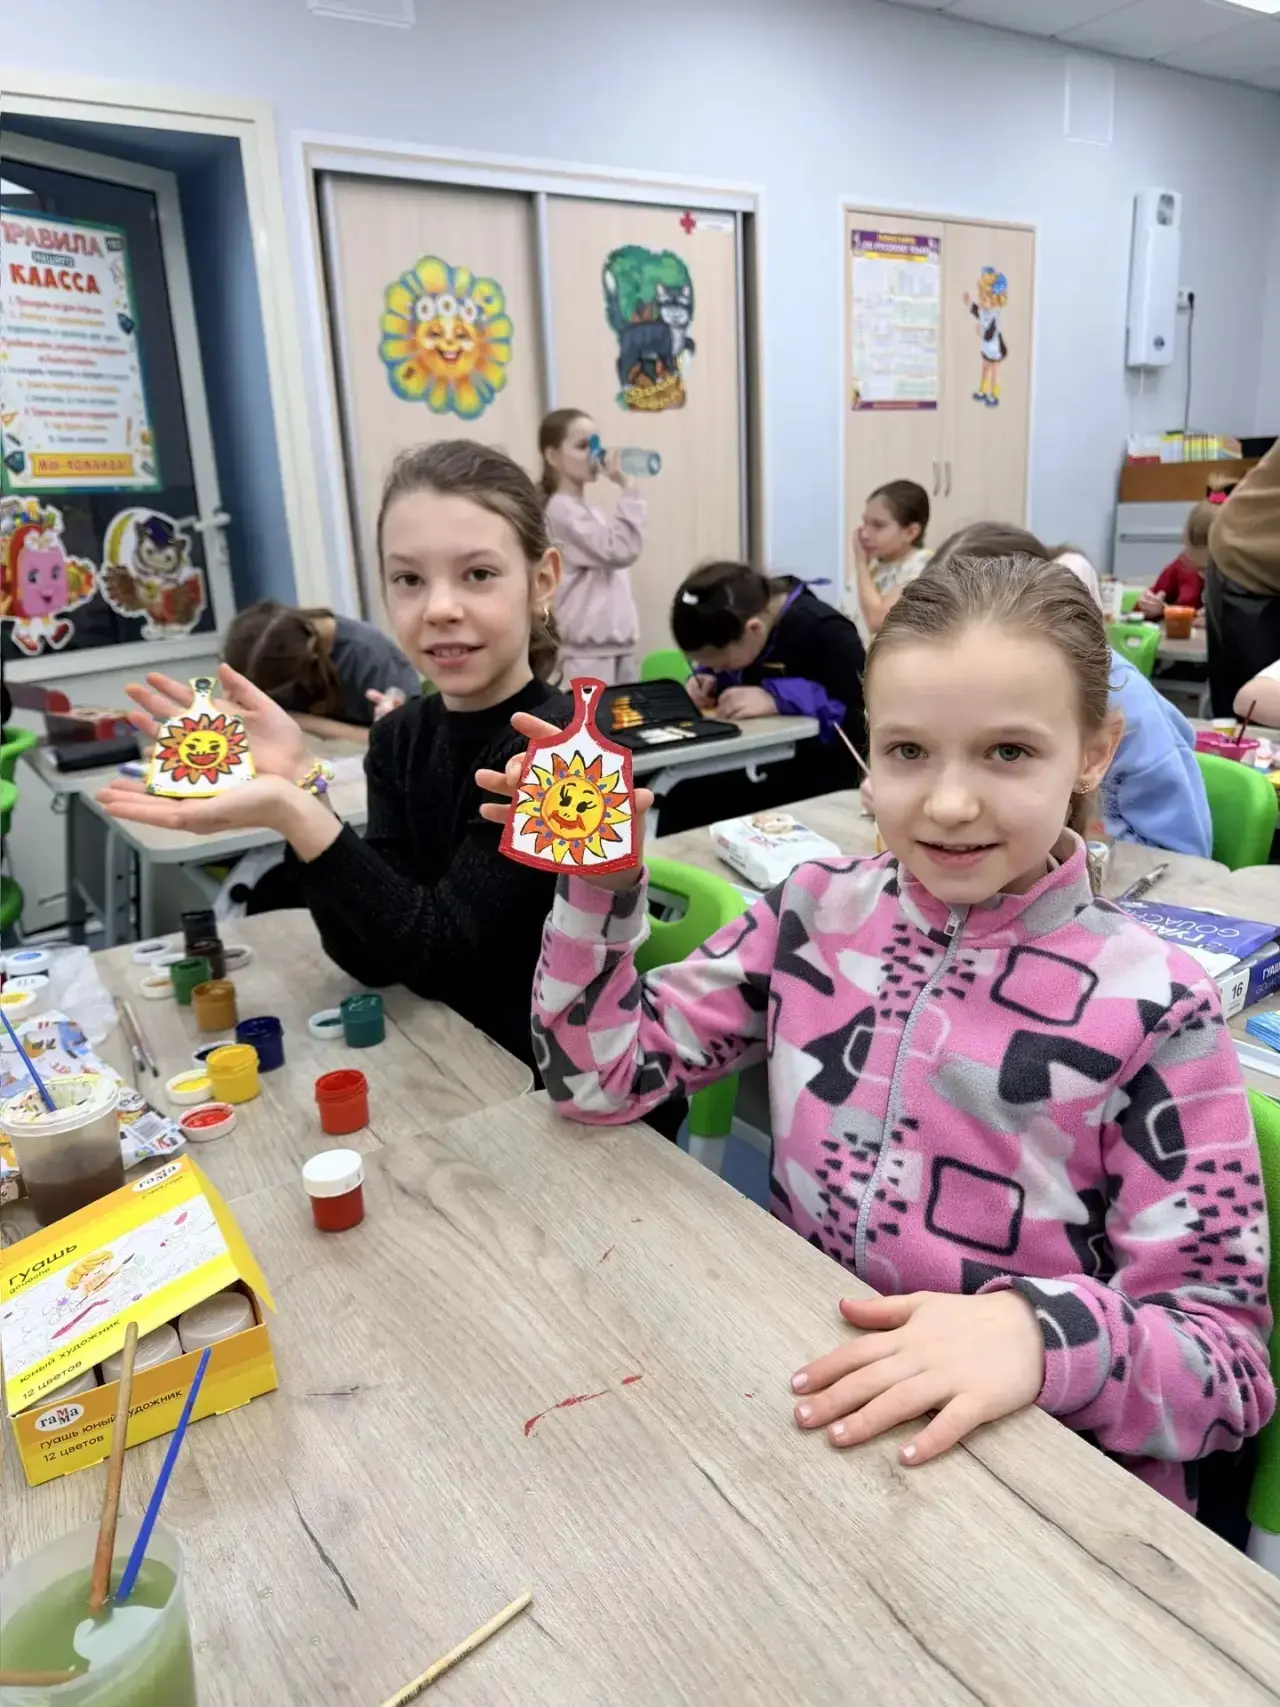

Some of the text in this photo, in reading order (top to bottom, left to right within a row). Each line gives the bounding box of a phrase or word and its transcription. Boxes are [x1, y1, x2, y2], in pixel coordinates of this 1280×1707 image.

[1, 220, 104, 259] ПРАВИЛА
[8, 263, 101, 294] КЛАССА
[1232, 981, 1244, 999] 16
[8, 1244, 78, 1286] гуашь
[9, 1267, 51, 1295] gouache
[20, 1319, 121, 1384] юный художник
[22, 1360, 83, 1401] 12 цветов
[40, 1430, 79, 1450] гуашь
[127, 1389, 184, 1420] удожник
[43, 1434, 105, 1463] 12 цветов
